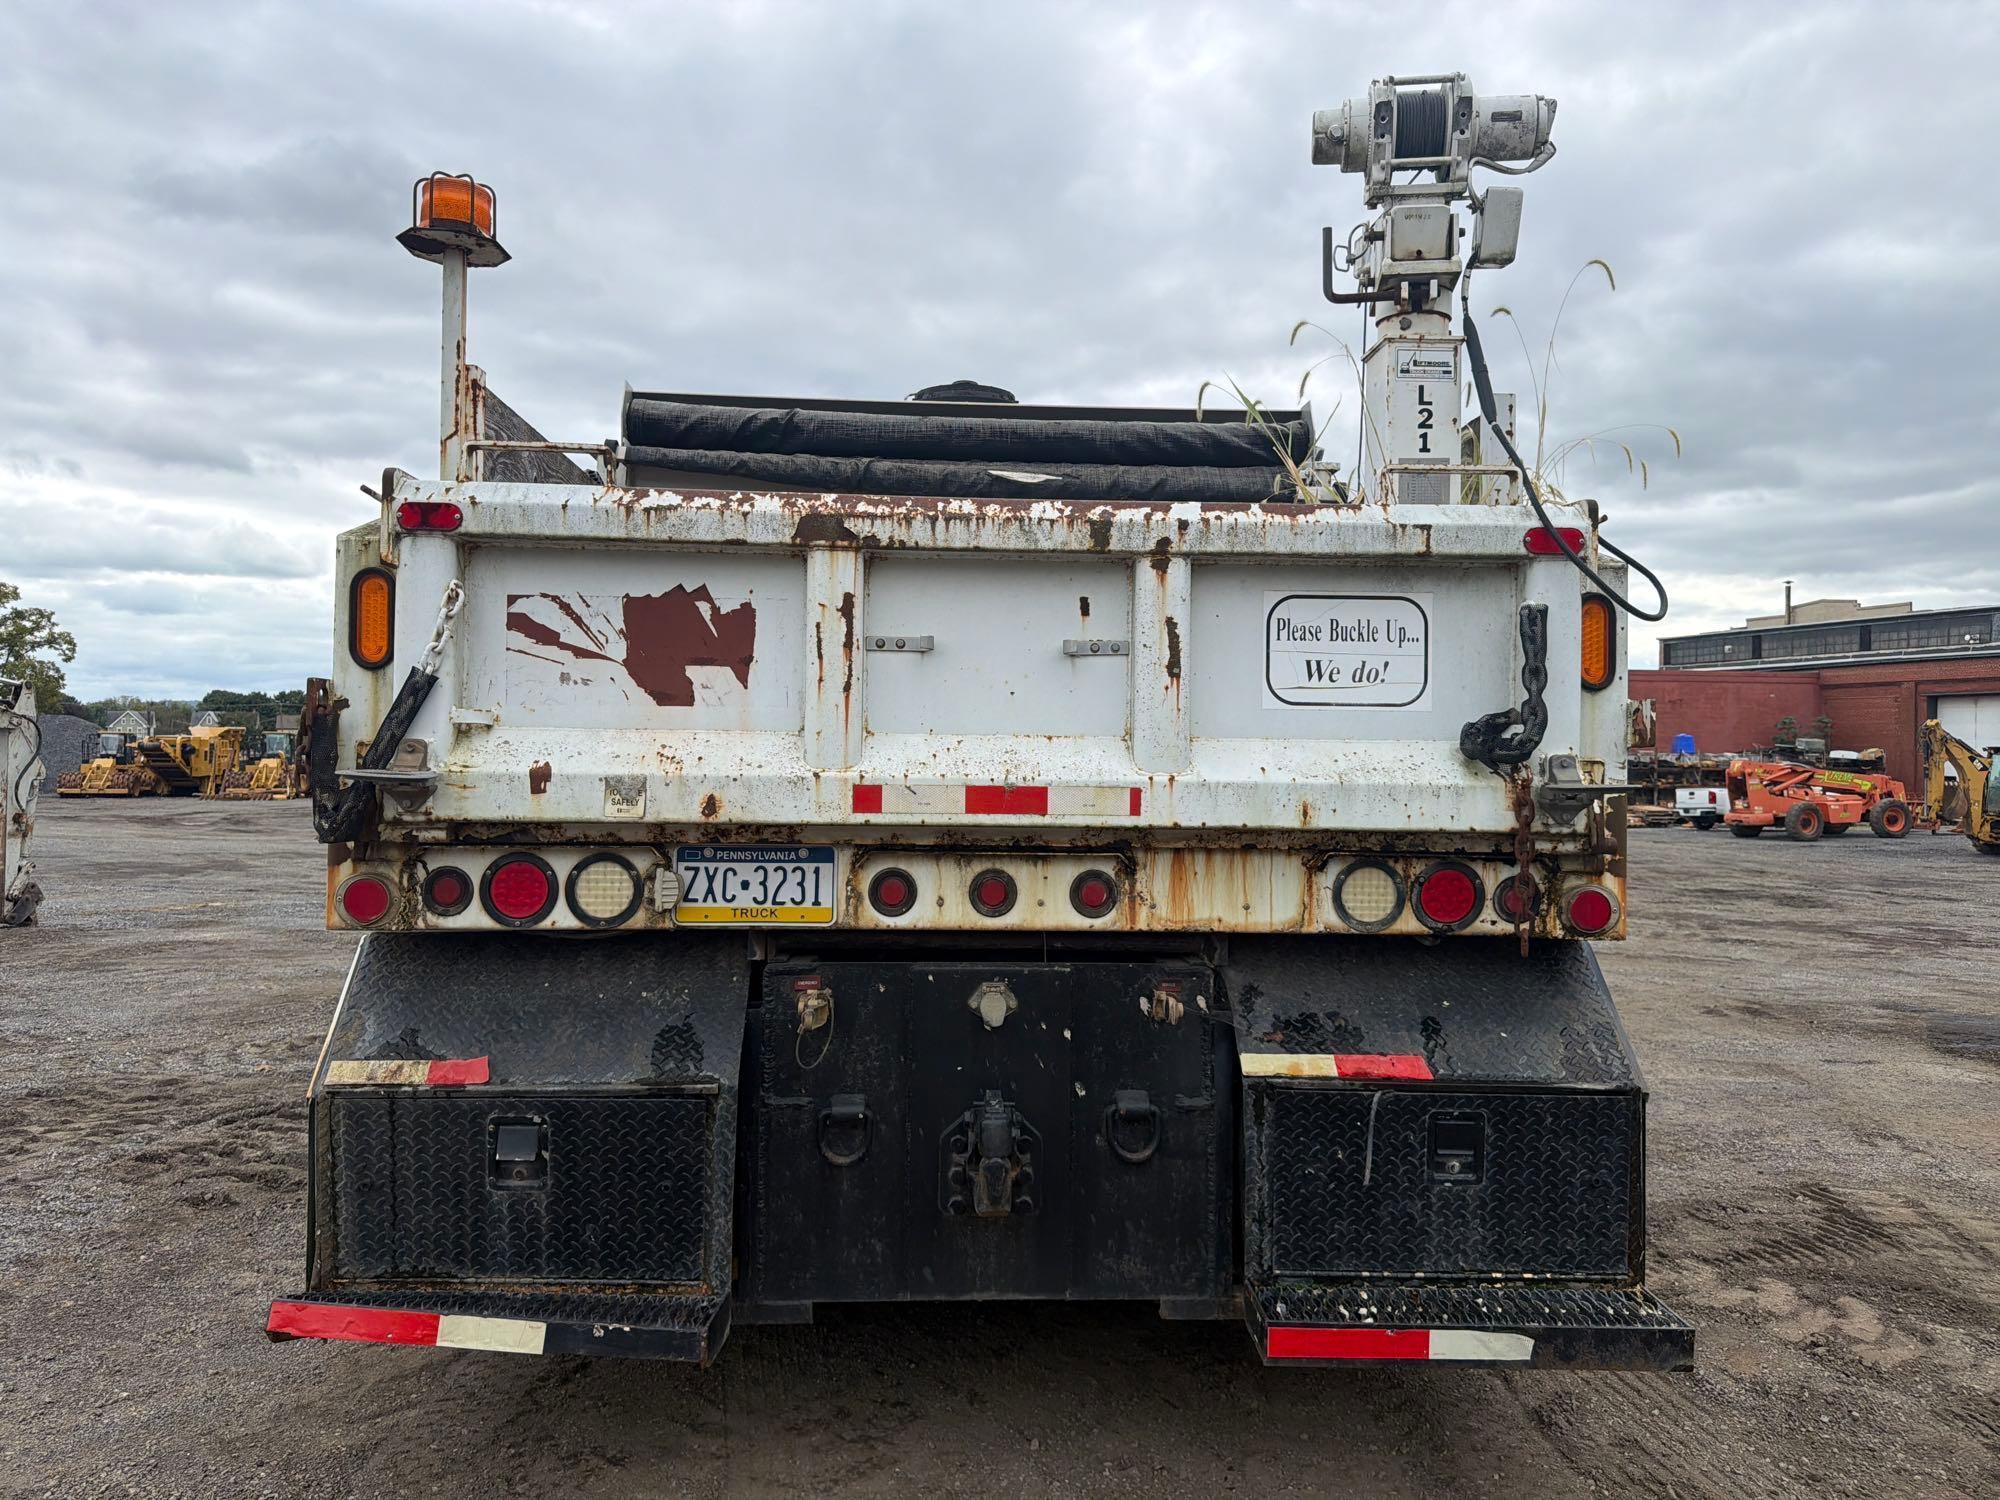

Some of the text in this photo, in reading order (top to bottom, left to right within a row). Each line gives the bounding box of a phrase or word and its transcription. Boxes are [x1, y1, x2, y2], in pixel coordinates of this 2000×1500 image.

[1276, 618, 1420, 648] Please Buckle Up...
[1305, 659, 1390, 684] We do!
[611, 798, 640, 807] SAFELY
[716, 851, 797, 861] PENNSYLVANIA
[731, 907, 778, 918] TRUCK
